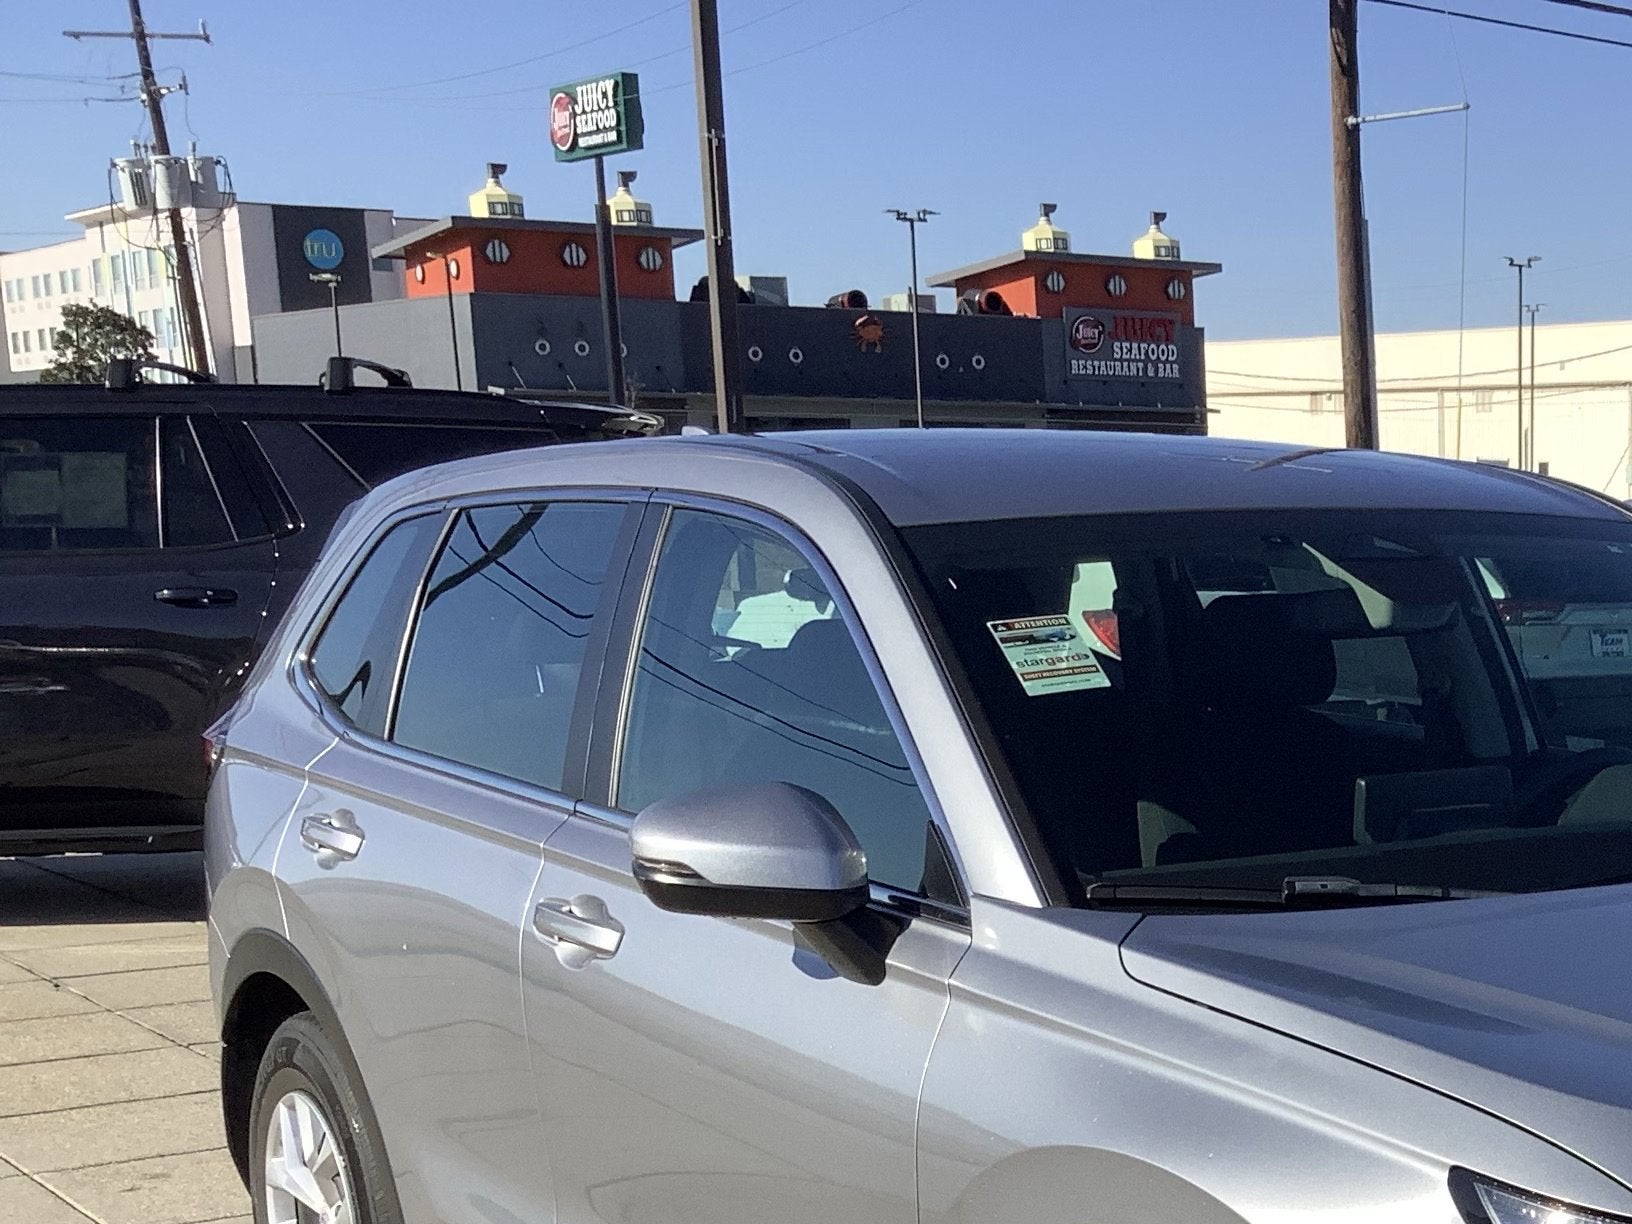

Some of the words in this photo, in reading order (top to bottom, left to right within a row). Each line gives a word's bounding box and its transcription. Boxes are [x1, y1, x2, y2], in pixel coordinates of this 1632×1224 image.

[574, 78, 615, 114] JUICY
[575, 107, 617, 134] SEAFOOD
[1108, 316, 1175, 343] JUICY
[1113, 342, 1178, 360] SEAFOOD
[1071, 359, 1144, 377] RESTAURANT
[1147, 362, 1155, 377] &
[1158, 363, 1180, 378] BAR
[1014, 617, 1067, 630] ATTENTION
